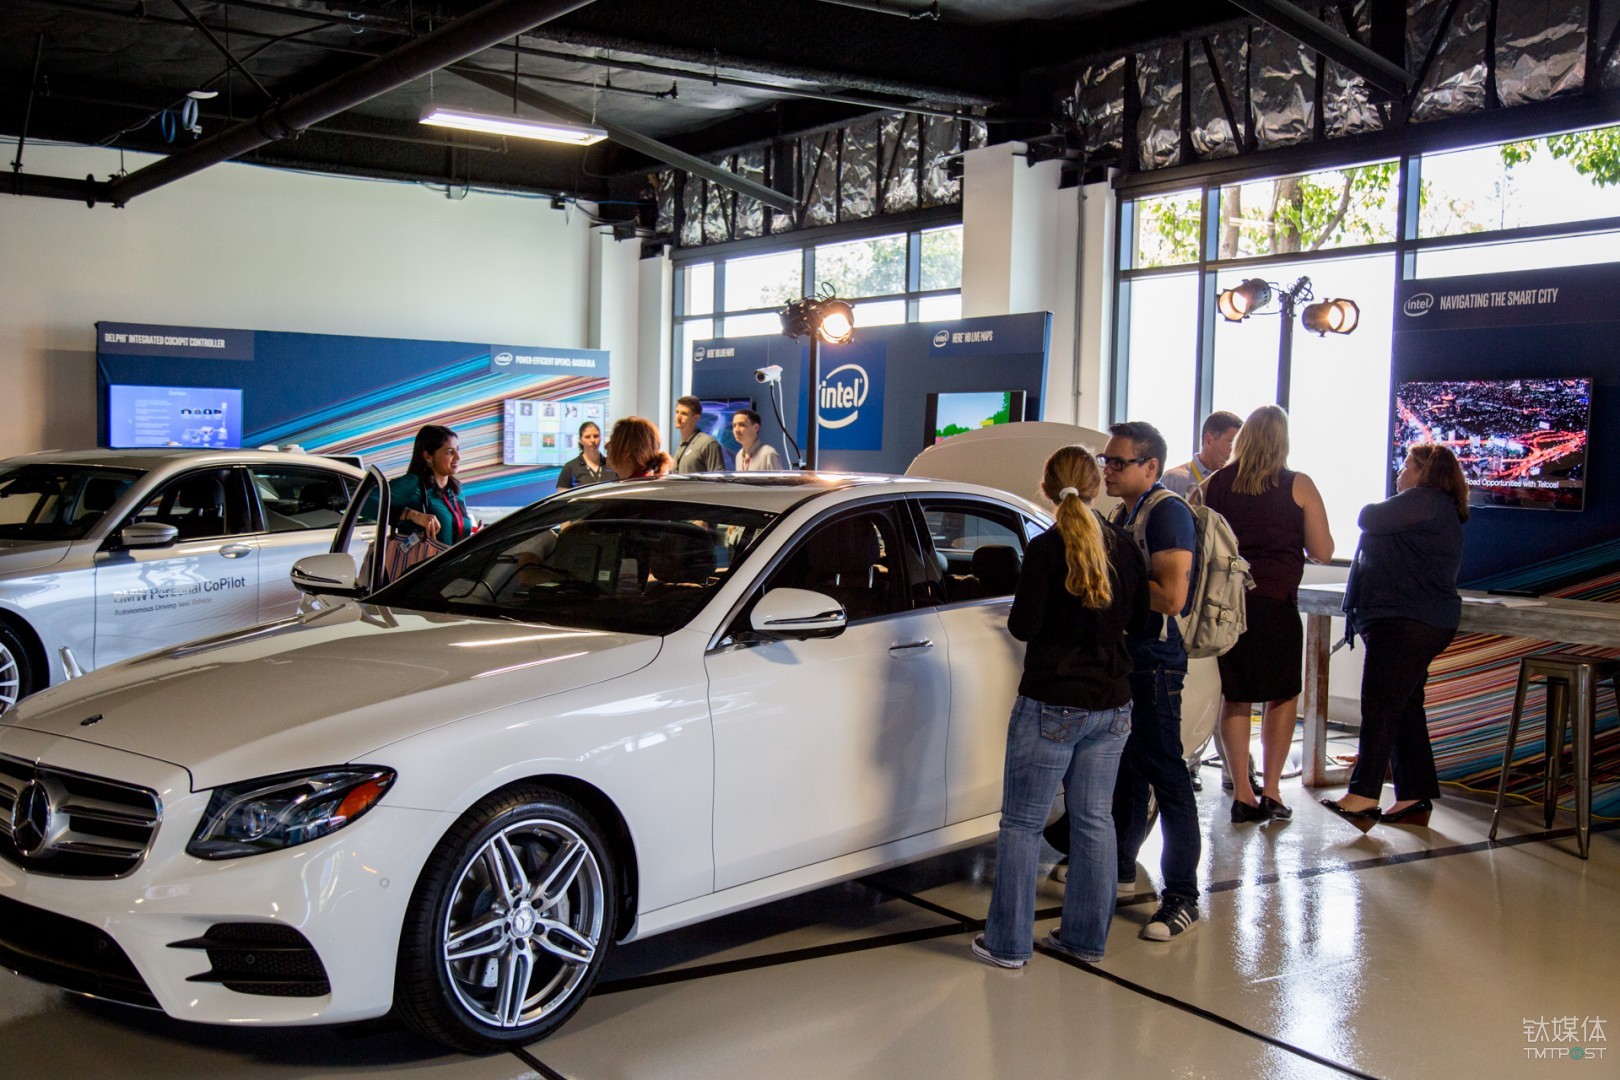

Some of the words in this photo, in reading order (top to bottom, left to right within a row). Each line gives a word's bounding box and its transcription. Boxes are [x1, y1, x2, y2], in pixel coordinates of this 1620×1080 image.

[1440, 293, 1489, 310] NAVIGATING
[1490, 292, 1506, 307] THE
[1507, 289, 1537, 306] SMART
[1537, 288, 1559, 304] CITY
[128, 334, 164, 345] INTEGRATED
[164, 336, 189, 347] COCKPIT
[189, 338, 226, 348] CONTROLLER
[820, 377, 860, 409] intel
[1481, 478, 1522, 488] Opportunities
[1522, 480, 1536, 488] with
[150, 583, 201, 600] Persal
[203, 576, 246, 592] CoPilot
[114, 606, 154, 616] Autonomous
[154, 603, 177, 611] Driving
